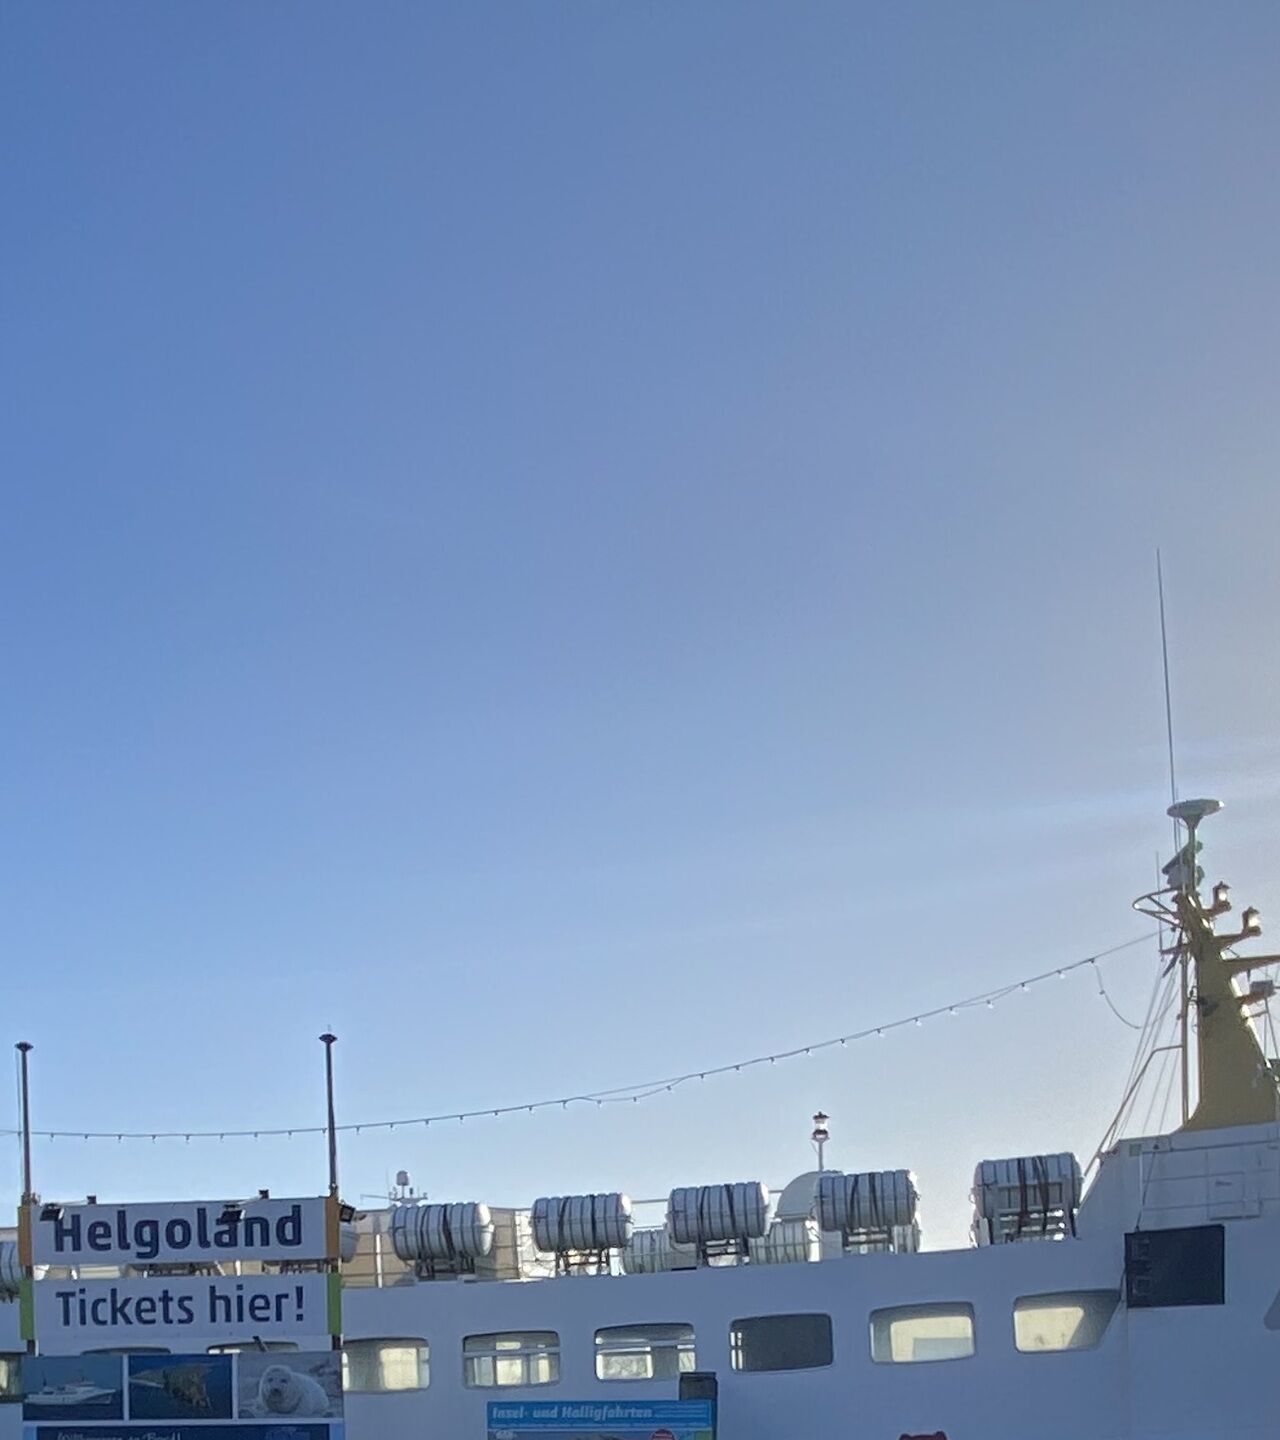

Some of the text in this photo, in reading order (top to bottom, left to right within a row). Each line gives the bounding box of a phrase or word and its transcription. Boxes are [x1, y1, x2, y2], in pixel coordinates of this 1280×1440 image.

[53, 1204, 303, 1260] Helgoland
[55, 1284, 305, 1327] Tickets hier!
[533, 1407, 559, 1419] und
[561, 1405, 653, 1421] Halligfahrten
